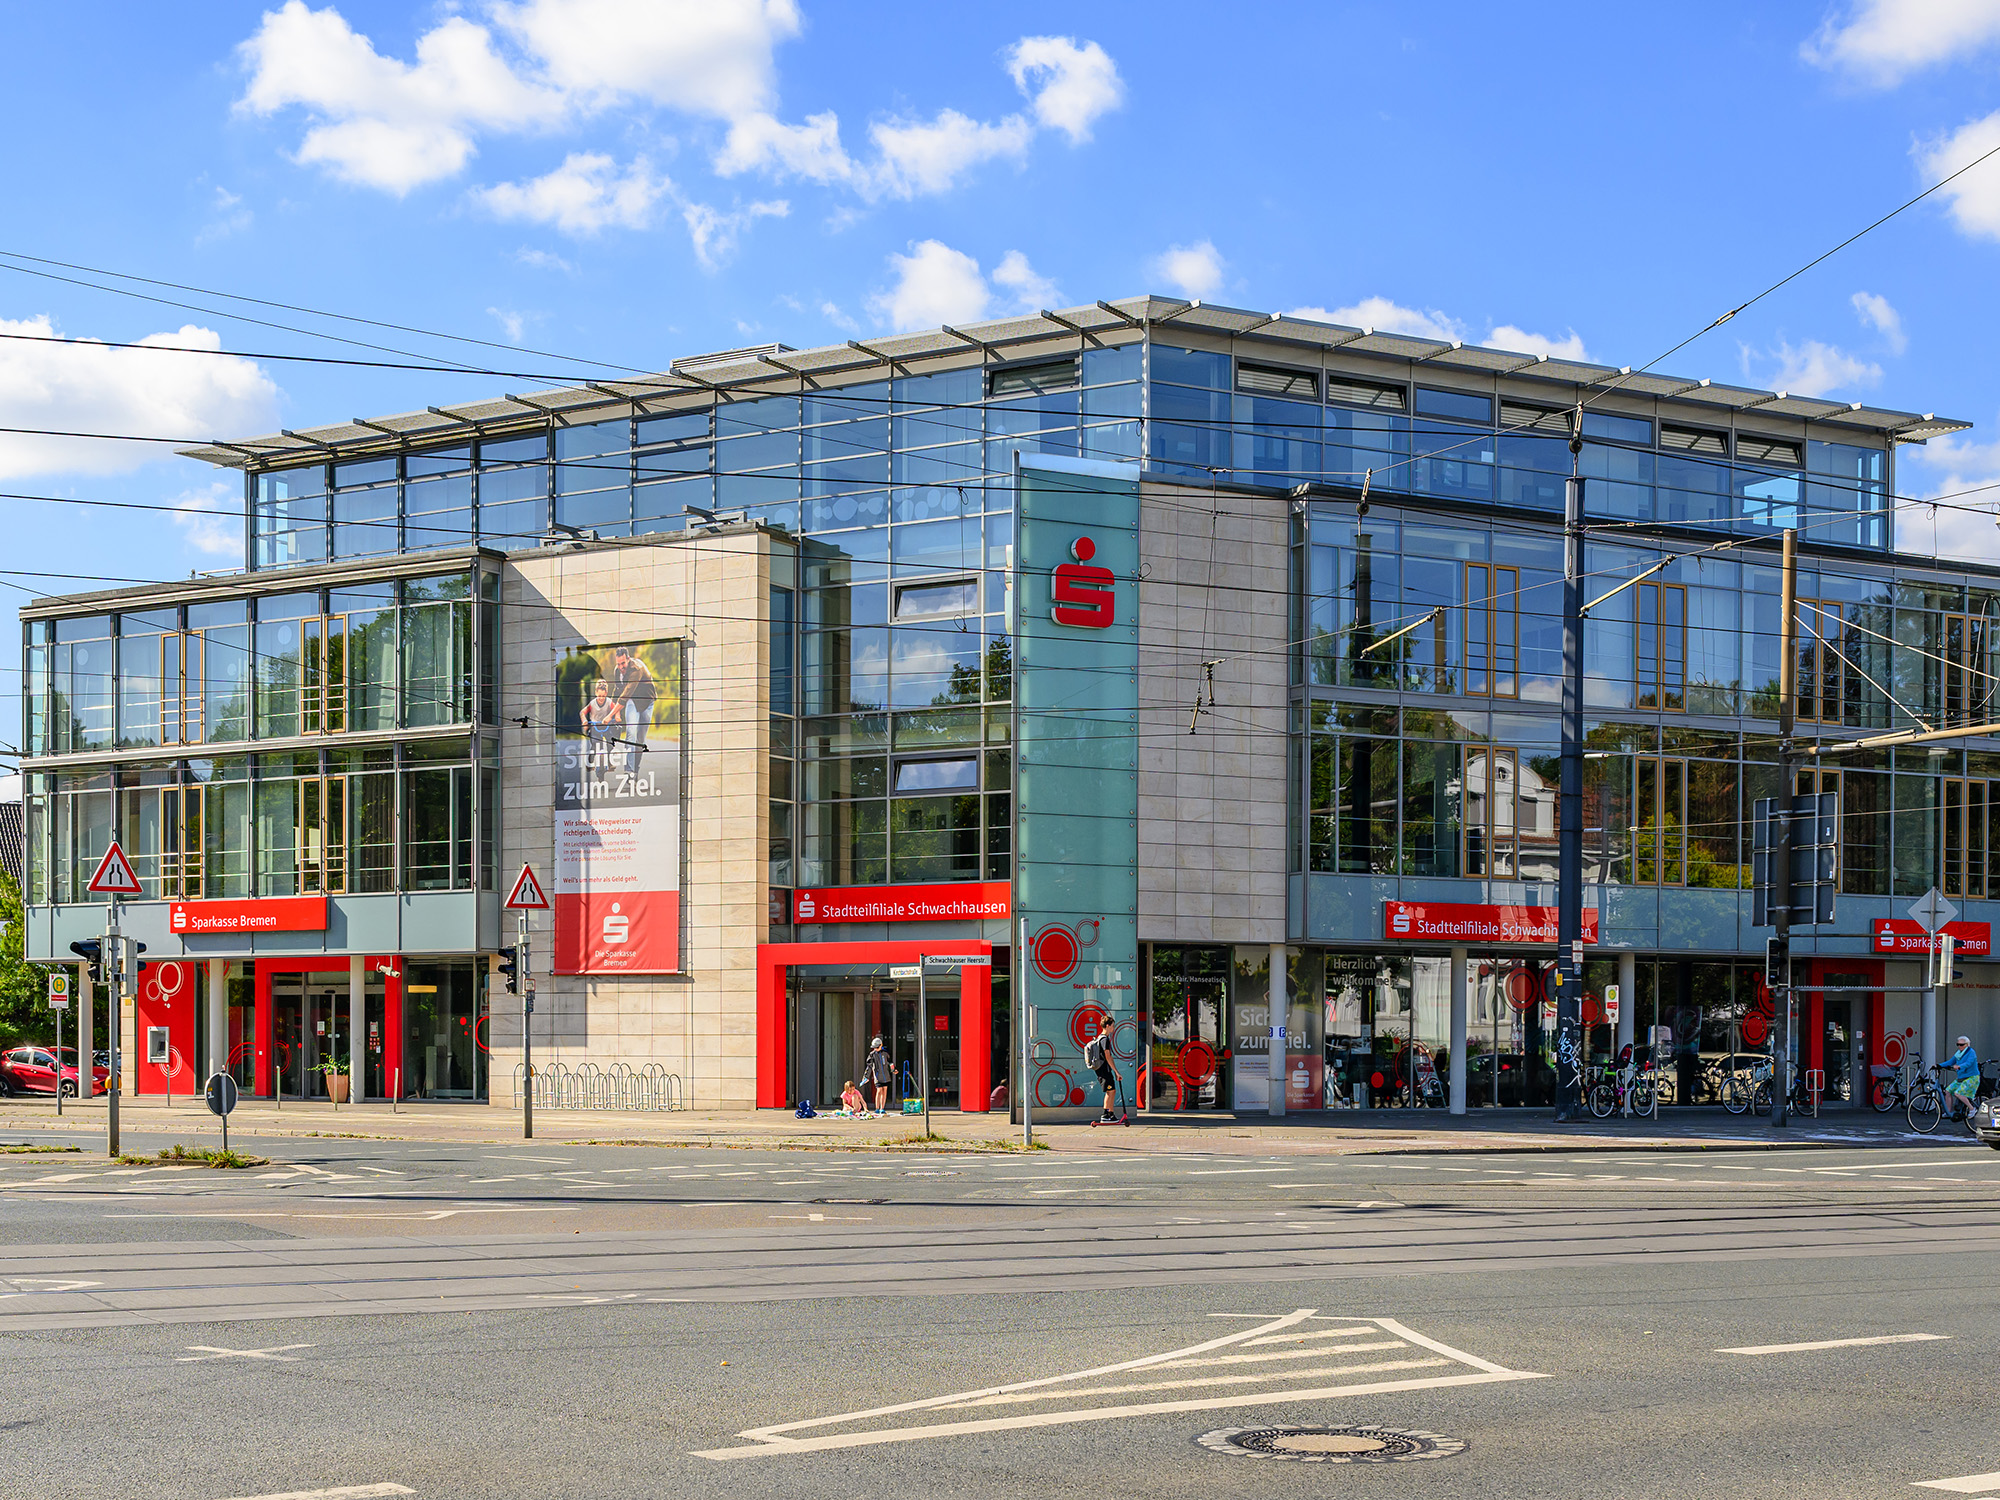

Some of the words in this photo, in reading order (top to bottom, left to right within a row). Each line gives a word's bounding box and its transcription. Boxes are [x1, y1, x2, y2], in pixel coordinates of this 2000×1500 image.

[564, 743, 632, 769] Sicher
[563, 780, 609, 800] zum
[615, 771, 662, 798] Ziel.
[598, 818, 631, 826] Wegweiser
[592, 828, 633, 836] Entscheidung.
[822, 902, 904, 918] Stadtteilfiliale
[908, 901, 1006, 916] Schwachhausen
[192, 916, 238, 930] Sparkasse
[240, 915, 276, 926] Bremen
[1417, 920, 1498, 934] Stadtteilfiliale
[1502, 922, 1592, 937] Schwachhen
[606, 950, 637, 958] Sparkasse
[1333, 958, 1376, 970] Herzlich
